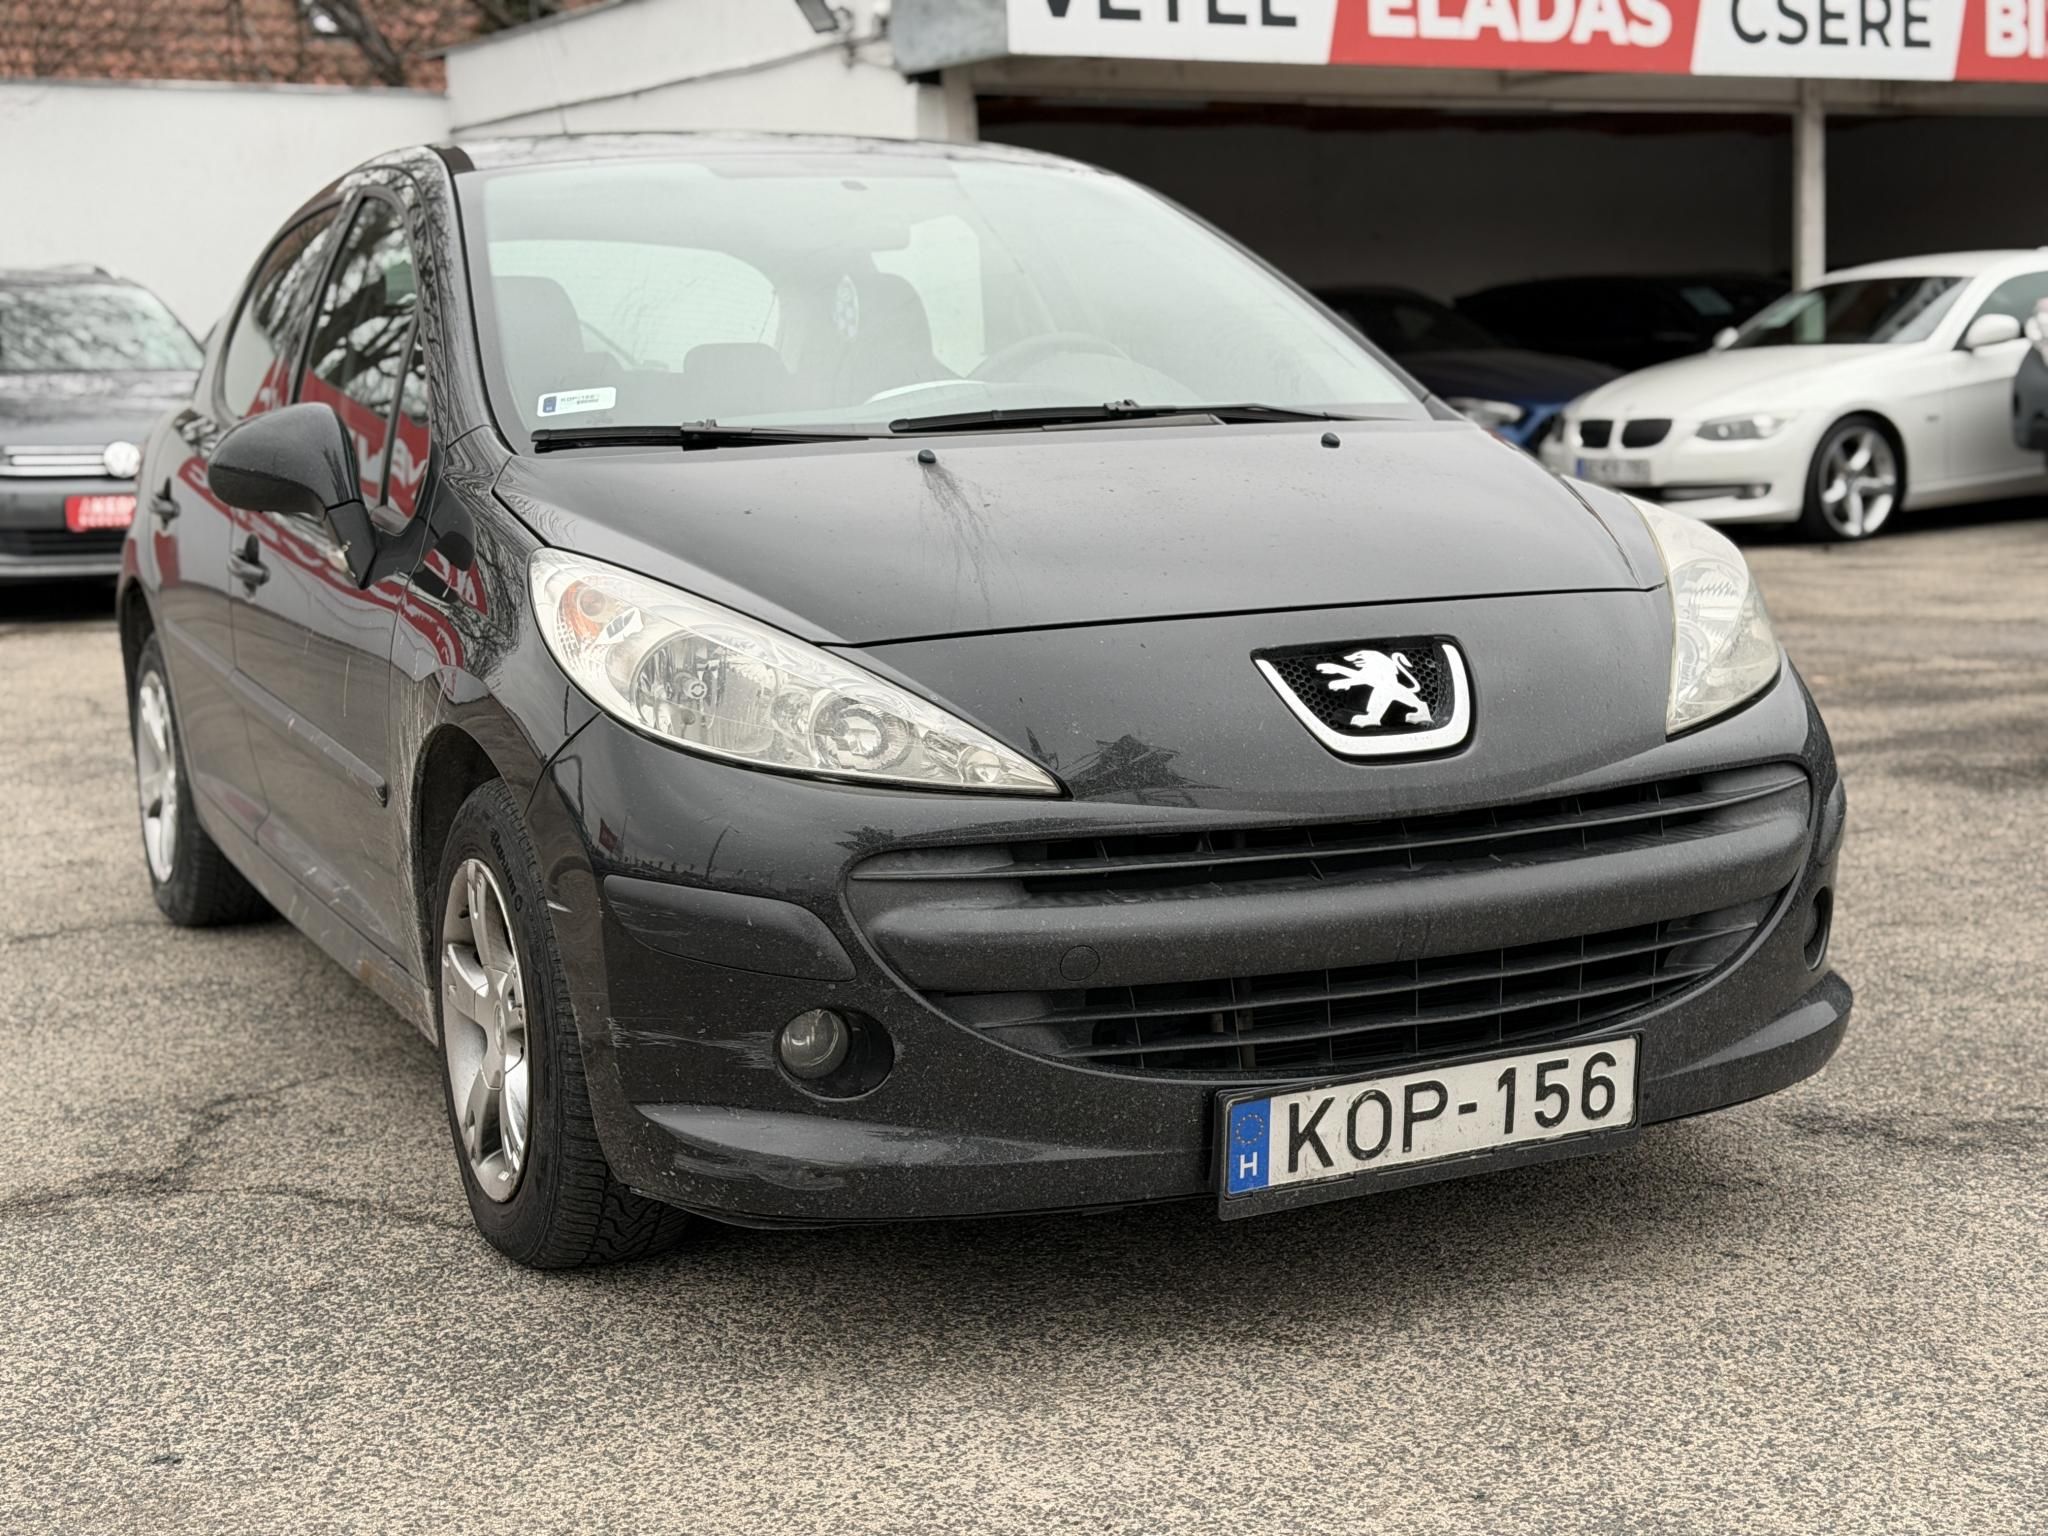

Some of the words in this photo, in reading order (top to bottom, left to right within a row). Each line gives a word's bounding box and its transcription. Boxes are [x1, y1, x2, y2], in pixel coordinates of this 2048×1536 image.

[1731, 0, 1931, 48] CSERE
[1239, 1151, 1258, 1179] H
[1288, 1052, 1617, 1173] KOP-156
